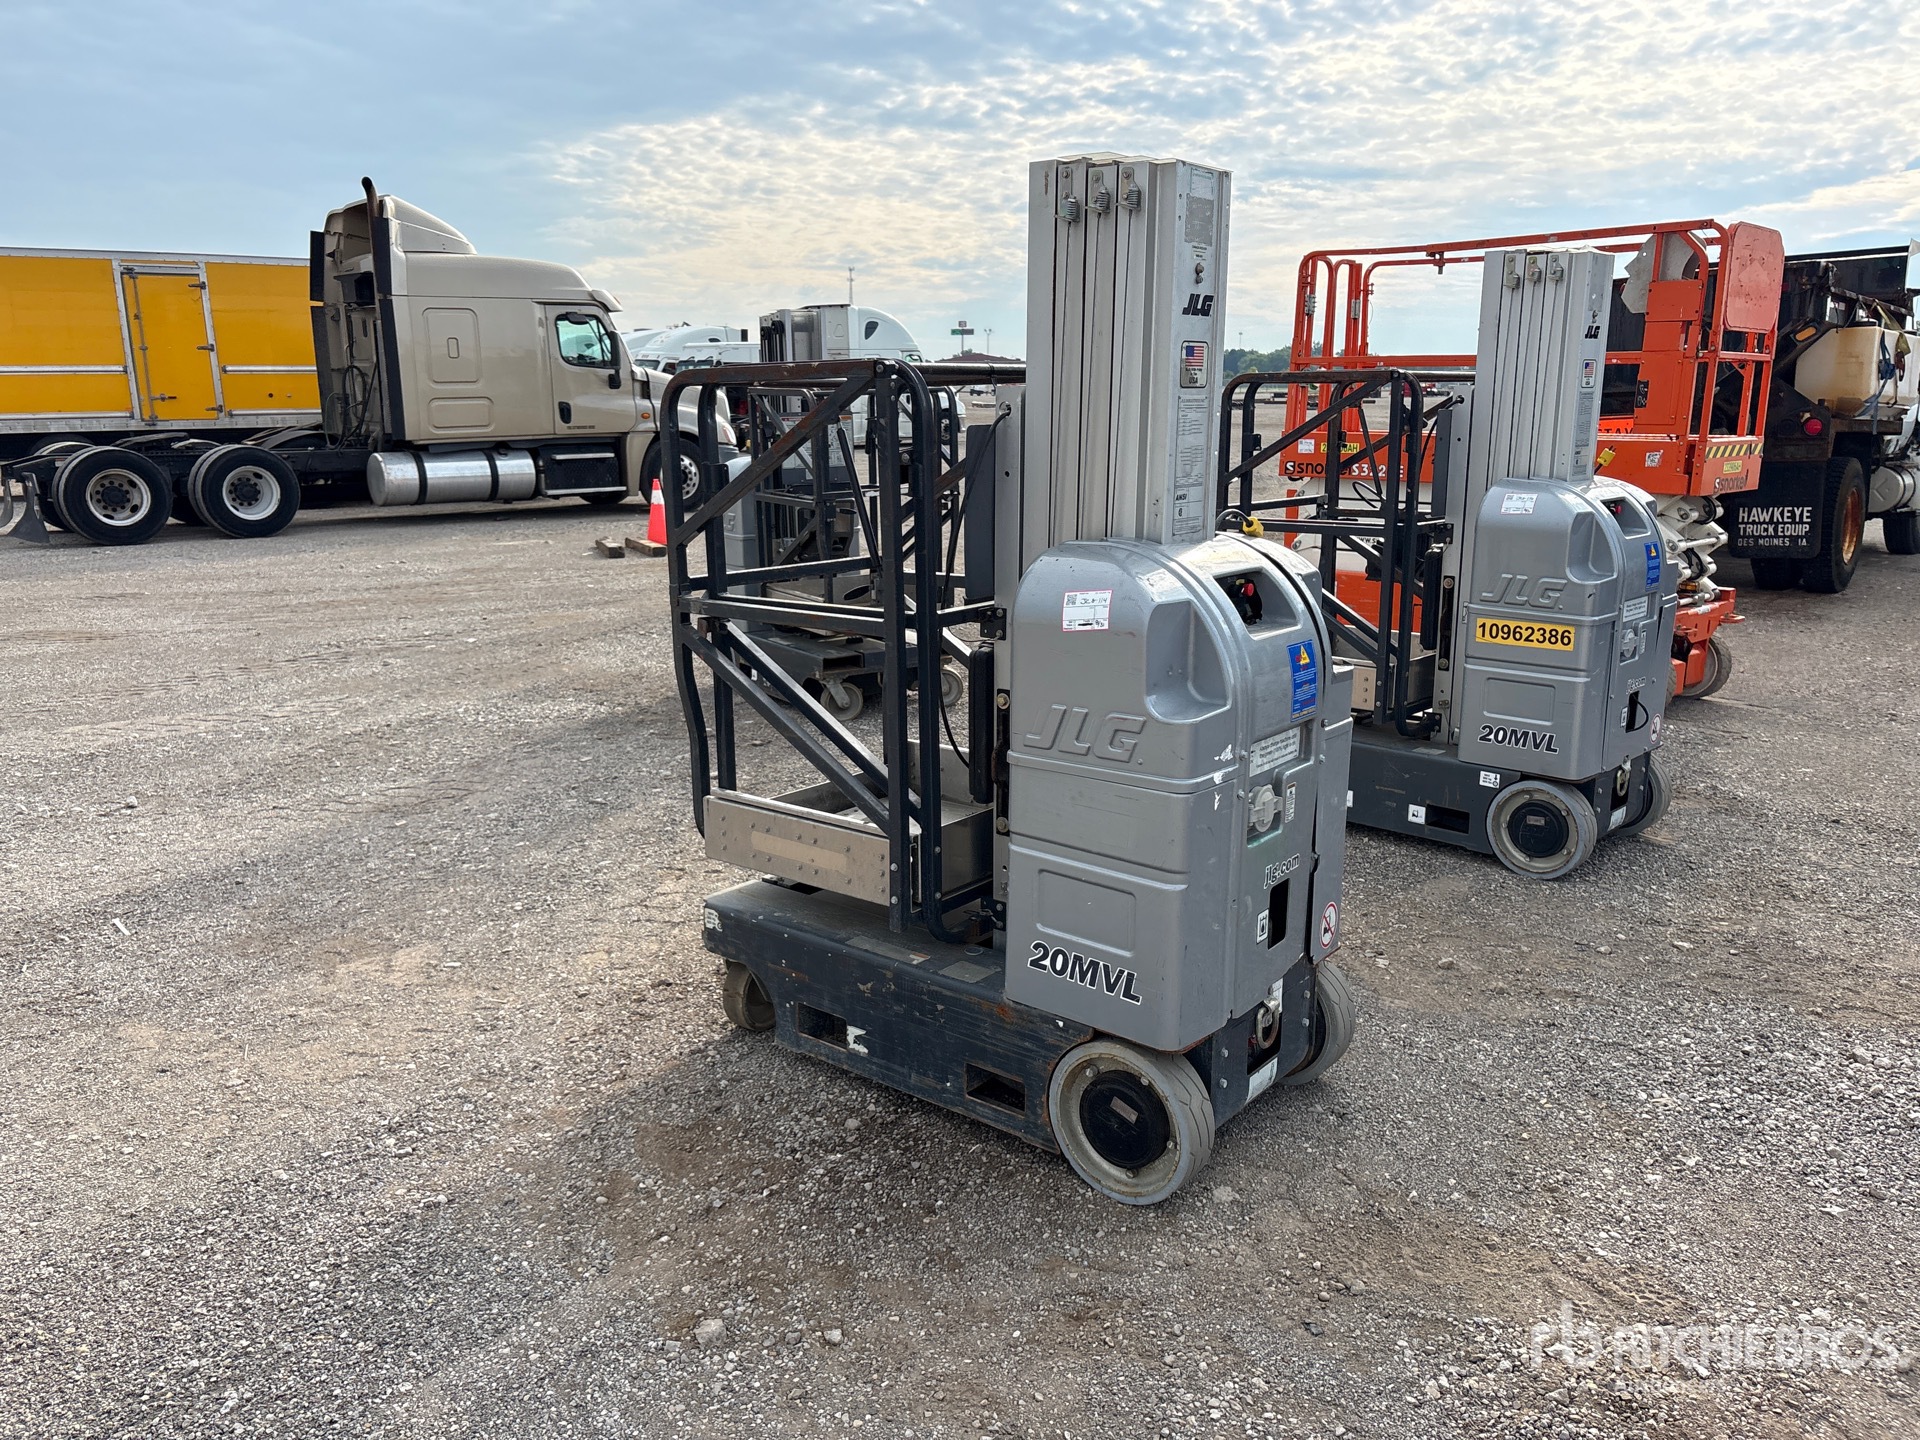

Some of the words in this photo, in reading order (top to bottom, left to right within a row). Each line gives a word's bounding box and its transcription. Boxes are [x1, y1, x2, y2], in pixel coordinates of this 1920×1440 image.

[1182, 293, 1214, 317] JLG
[1584, 325, 1600, 339] JLG
[1738, 507, 1812, 523] HAWKEYE
[1737, 538, 1754, 546] DES
[1738, 524, 1775, 536] TRUCK
[1778, 524, 1811, 536] EQUIP.
[1480, 573, 1567, 610] JLG
[1478, 622, 1572, 646] 10962386
[1023, 704, 1147, 764] JLG
[1477, 723, 1560, 754] 20MVL
[1264, 853, 1300, 889] jlg.com
[1027, 940, 1142, 1005] 20MVL
